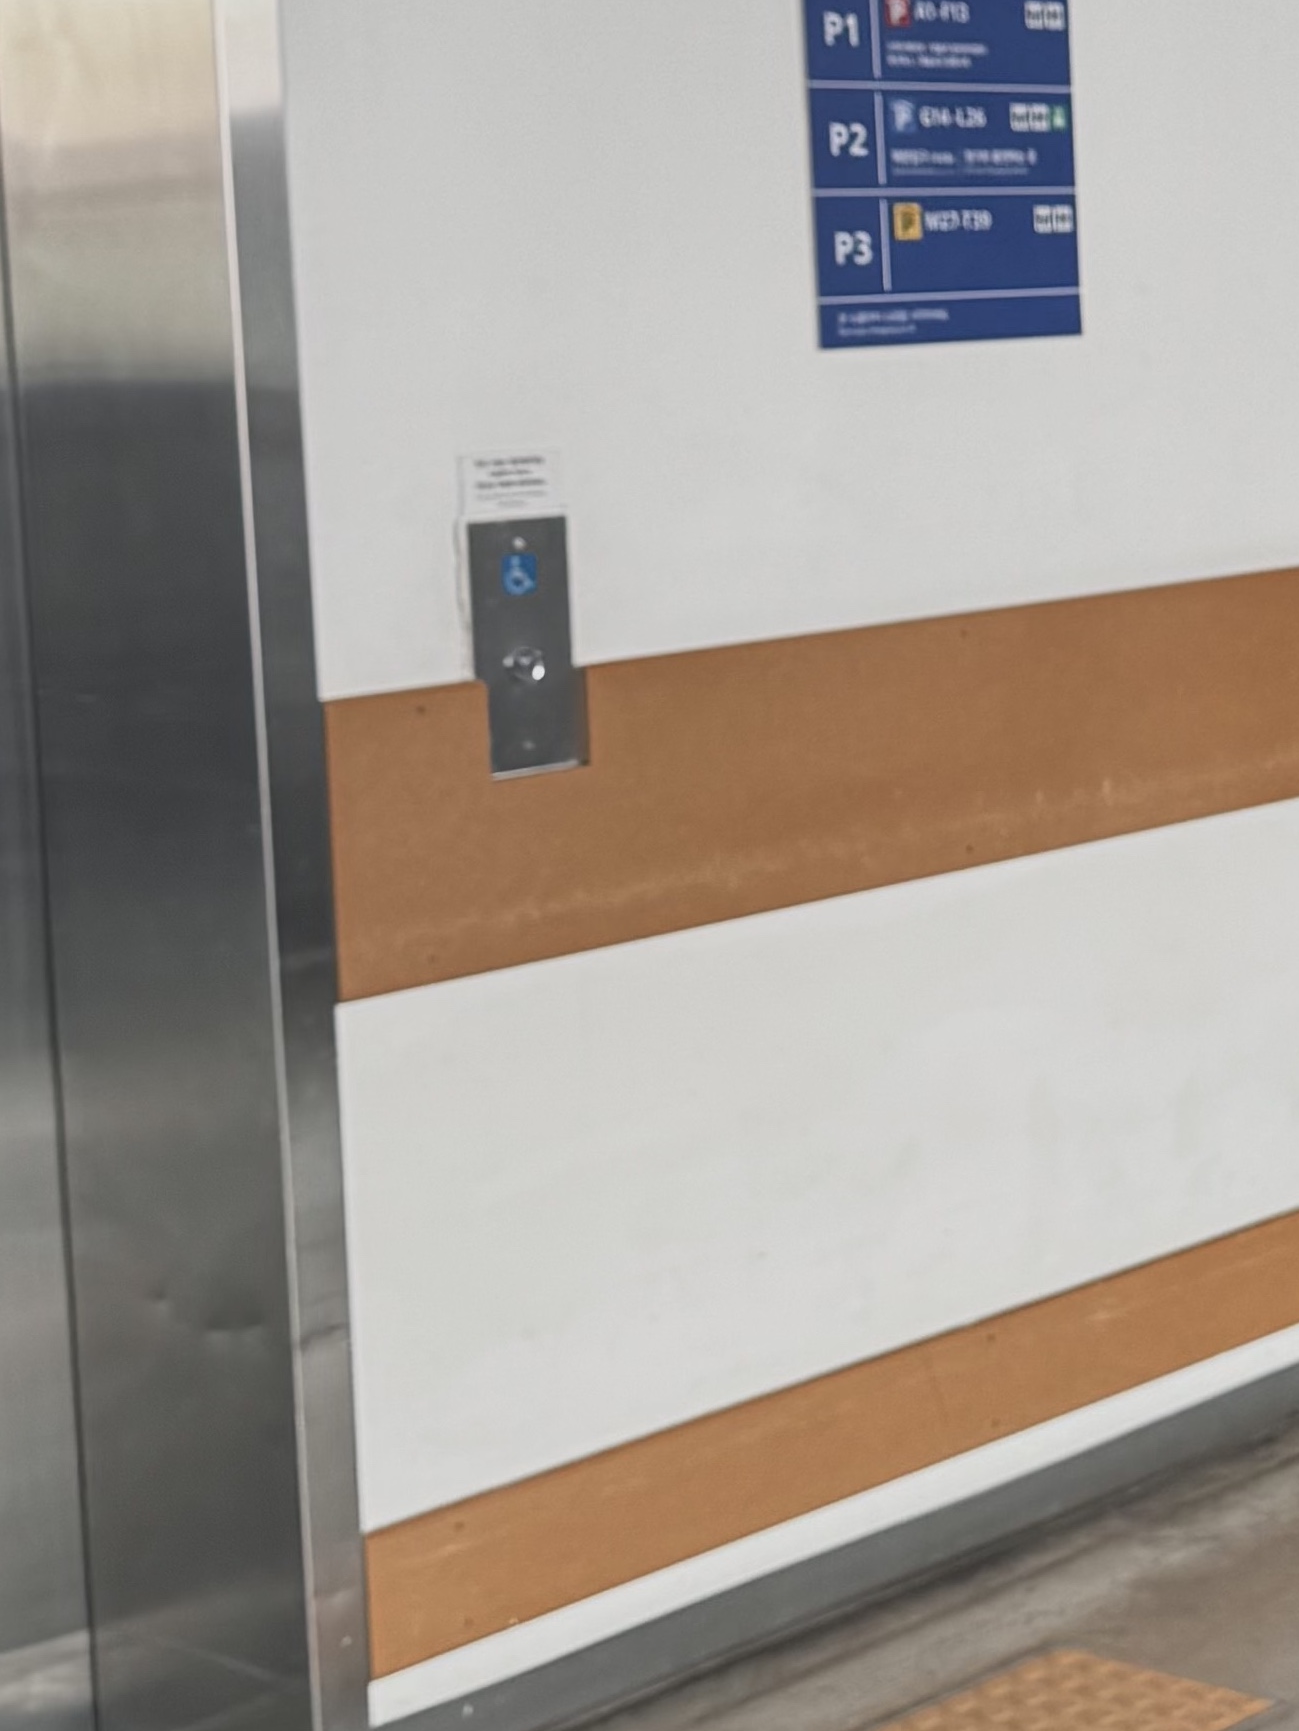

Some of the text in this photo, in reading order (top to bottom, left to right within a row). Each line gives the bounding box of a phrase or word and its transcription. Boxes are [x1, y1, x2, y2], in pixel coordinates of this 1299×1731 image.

[822, 10, 860, 47] P1
[829, 122, 869, 157] P2
[834, 230, 874, 266] P3
